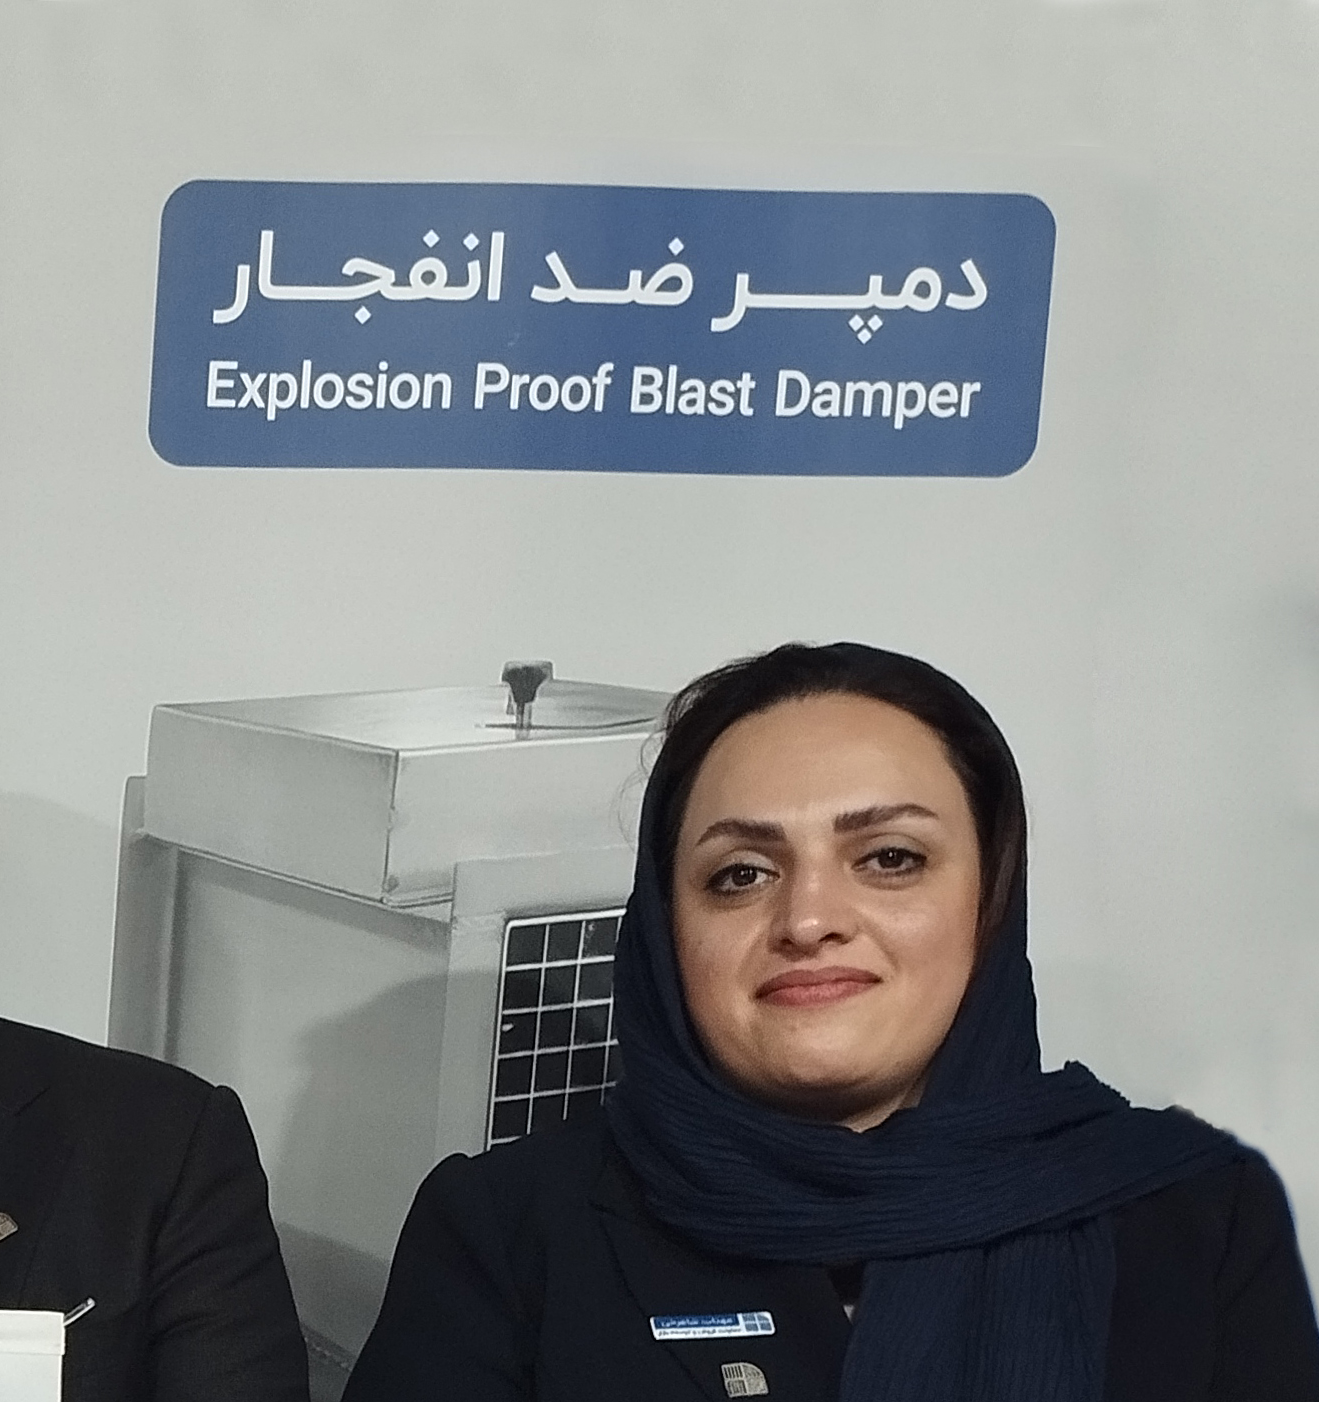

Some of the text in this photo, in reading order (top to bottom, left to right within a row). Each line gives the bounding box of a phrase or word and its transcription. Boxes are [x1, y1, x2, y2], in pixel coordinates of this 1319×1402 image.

[213, 229, 989, 344] دمپر ضد انفجار
[206, 360, 981, 427] Explosion Proof Blast Damper
